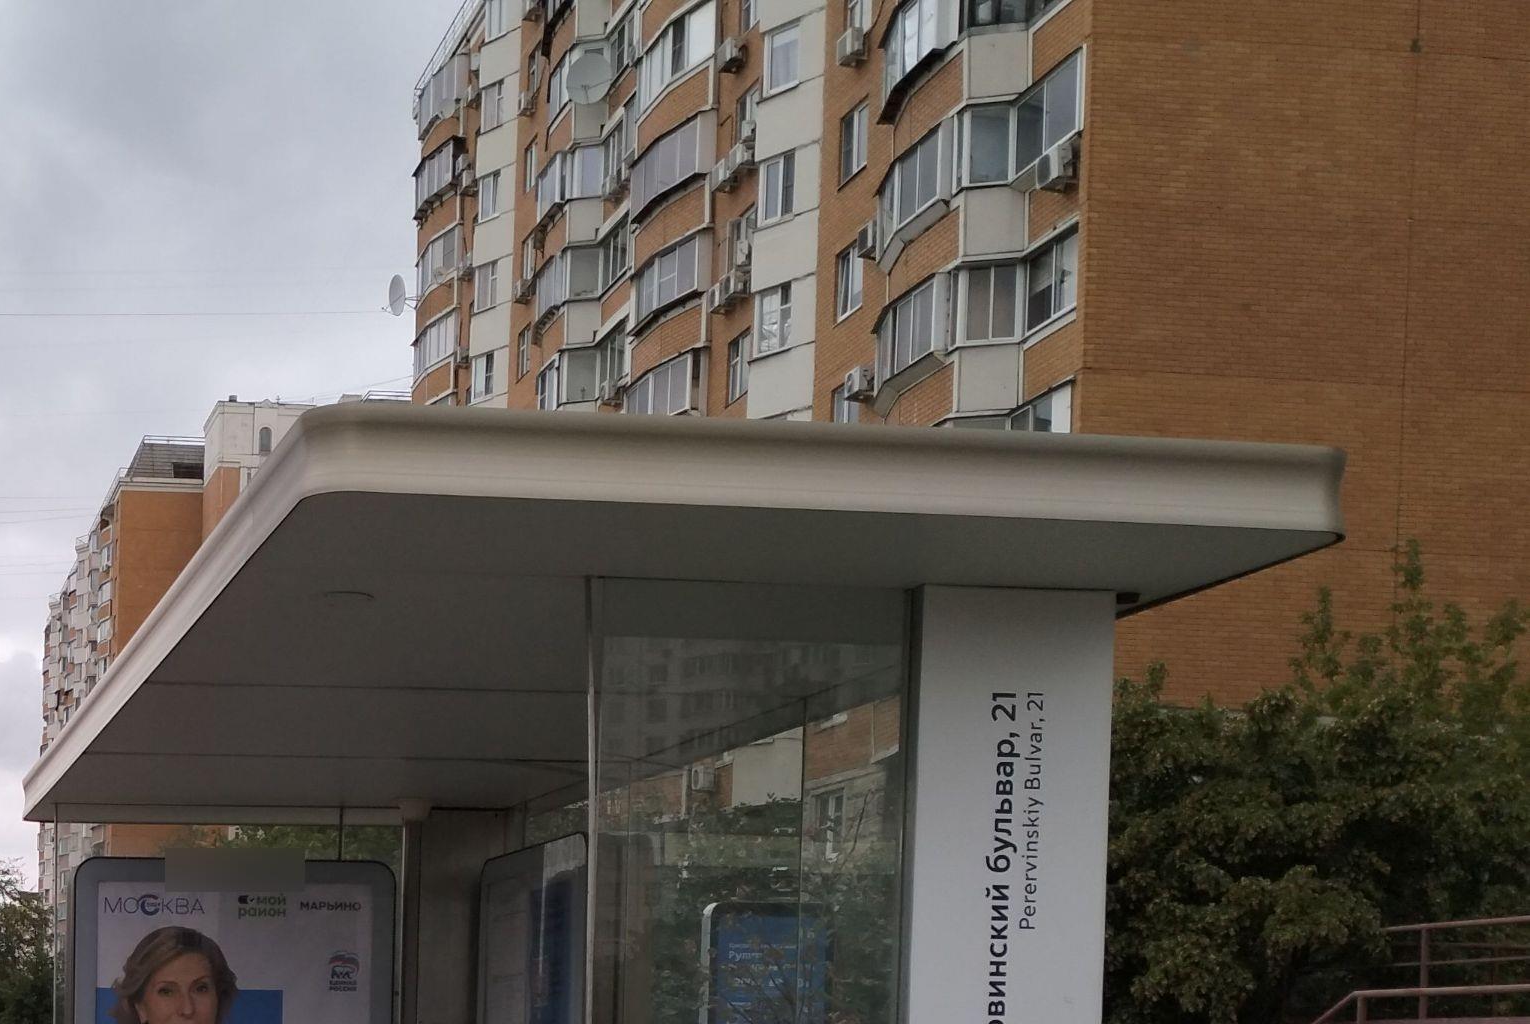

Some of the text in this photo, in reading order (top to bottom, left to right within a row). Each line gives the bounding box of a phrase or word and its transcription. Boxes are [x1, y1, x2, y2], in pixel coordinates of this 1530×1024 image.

[991, 692, 1017, 722] 21
[986, 732, 1020, 873] бульвар,
[1019, 692, 1046, 930] Perervinskiy Bulvar, 21
[103, 894, 206, 917] МОСКВА
[299, 901, 362, 912] МАРЬИНО
